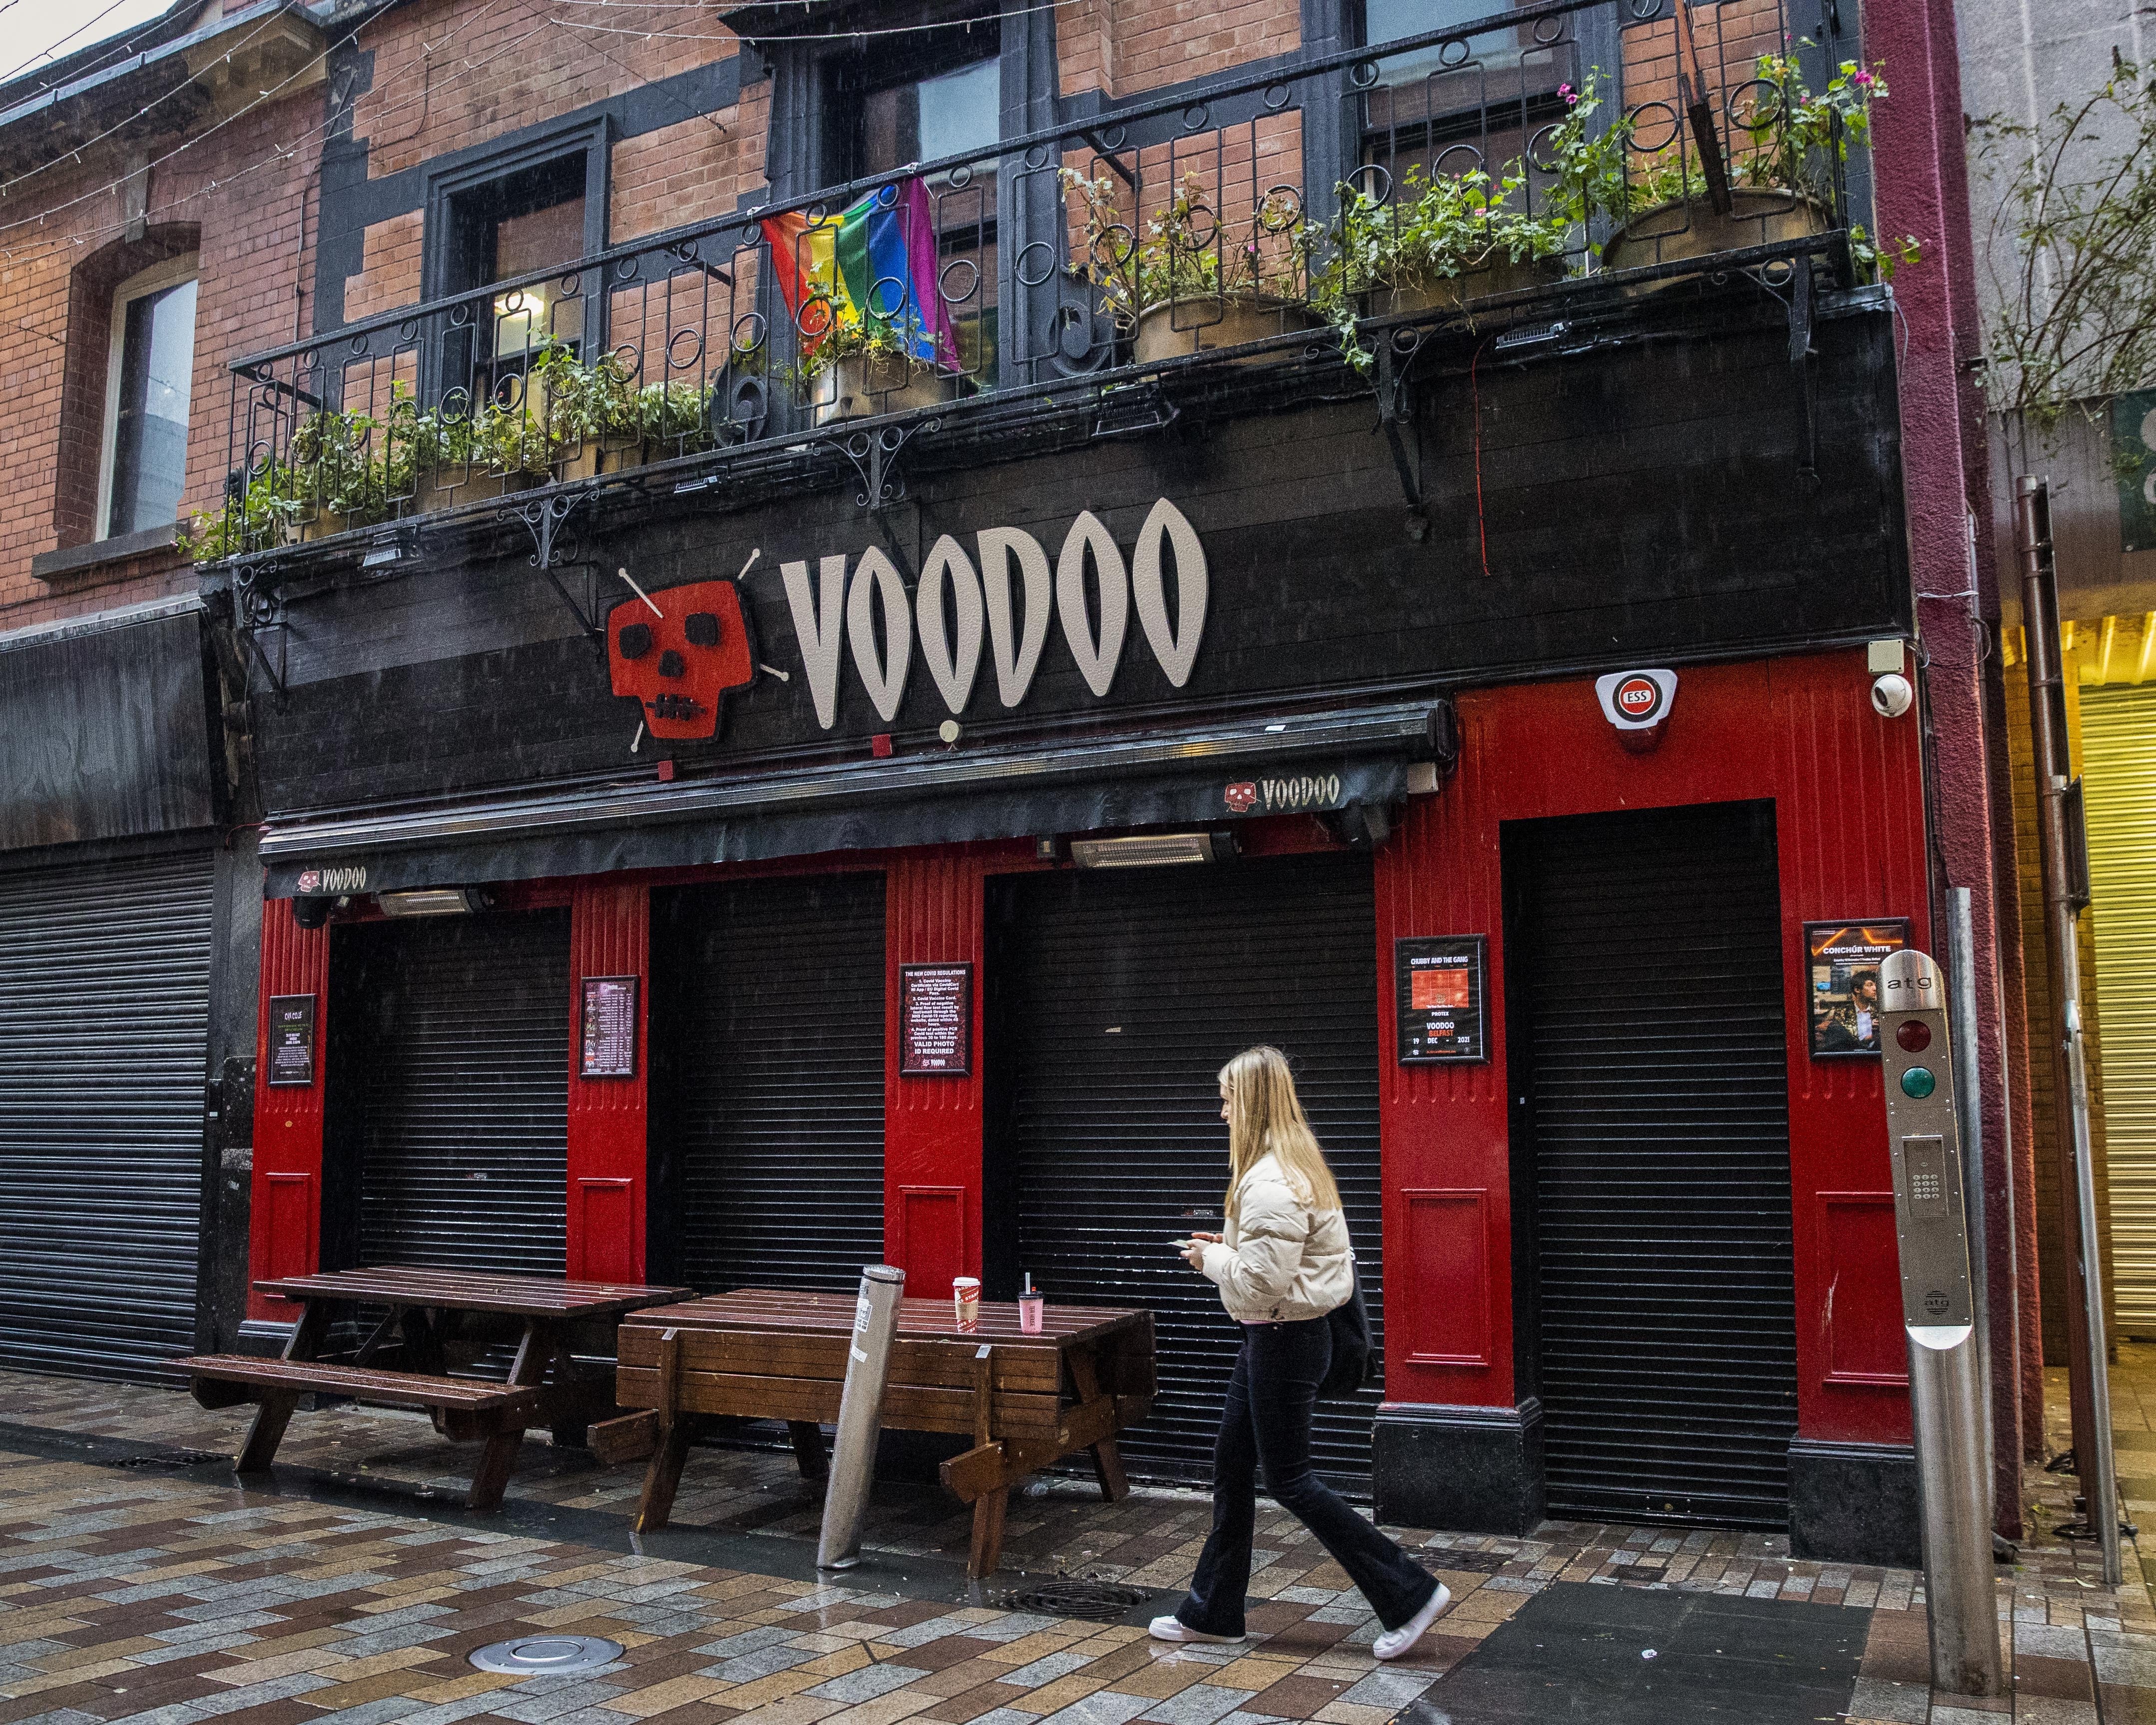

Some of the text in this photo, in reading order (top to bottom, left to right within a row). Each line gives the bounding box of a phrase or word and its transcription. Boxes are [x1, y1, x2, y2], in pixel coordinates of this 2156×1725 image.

[781, 497, 1209, 729] VOODOO
[1627, 691, 1646, 702] ESS
[1262, 773, 1339, 810] VOODOO
[323, 866, 366, 892] VOODOO
[1823, 945, 1862, 954] CONCHÚR
[1888, 977, 1931, 990] atg
[1924, 1299, 1949, 1307] atg
